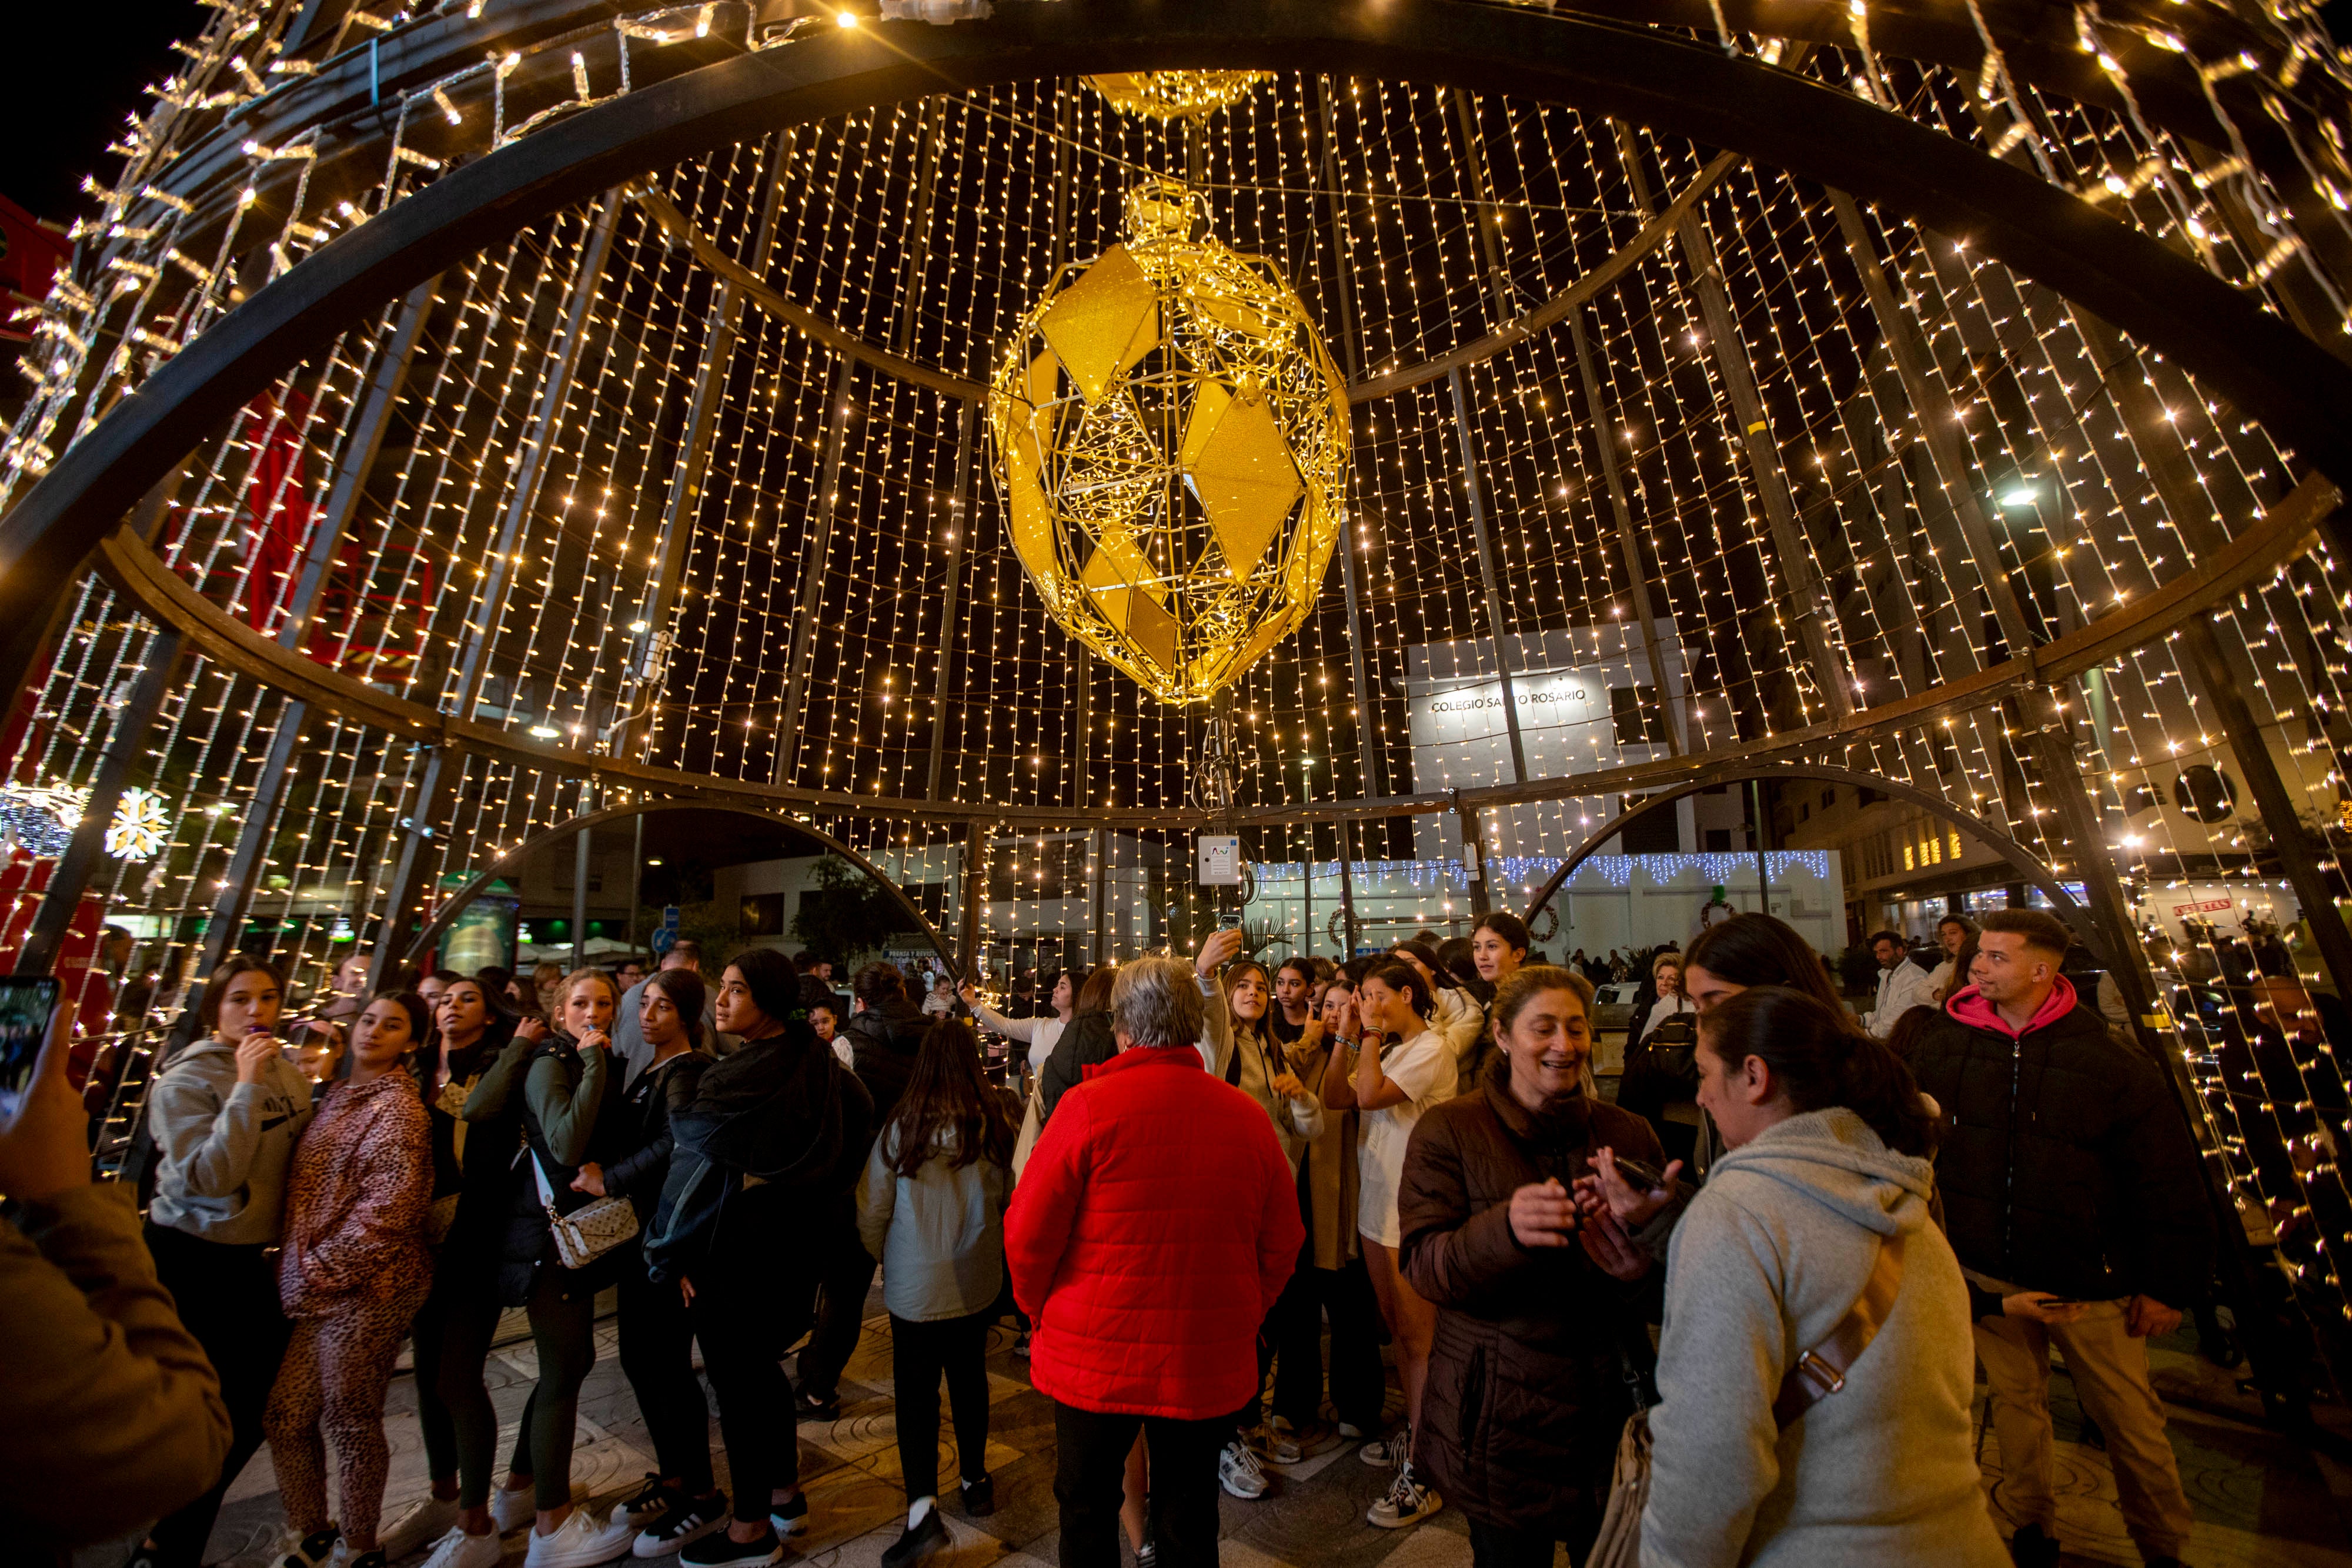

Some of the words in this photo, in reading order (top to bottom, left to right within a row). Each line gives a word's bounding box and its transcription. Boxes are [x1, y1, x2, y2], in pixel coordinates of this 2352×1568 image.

[1431, 698, 1484, 713] COLEGIO
[1486, 694, 1528, 708] SAO
[1531, 690, 1585, 704] ROSARIO
